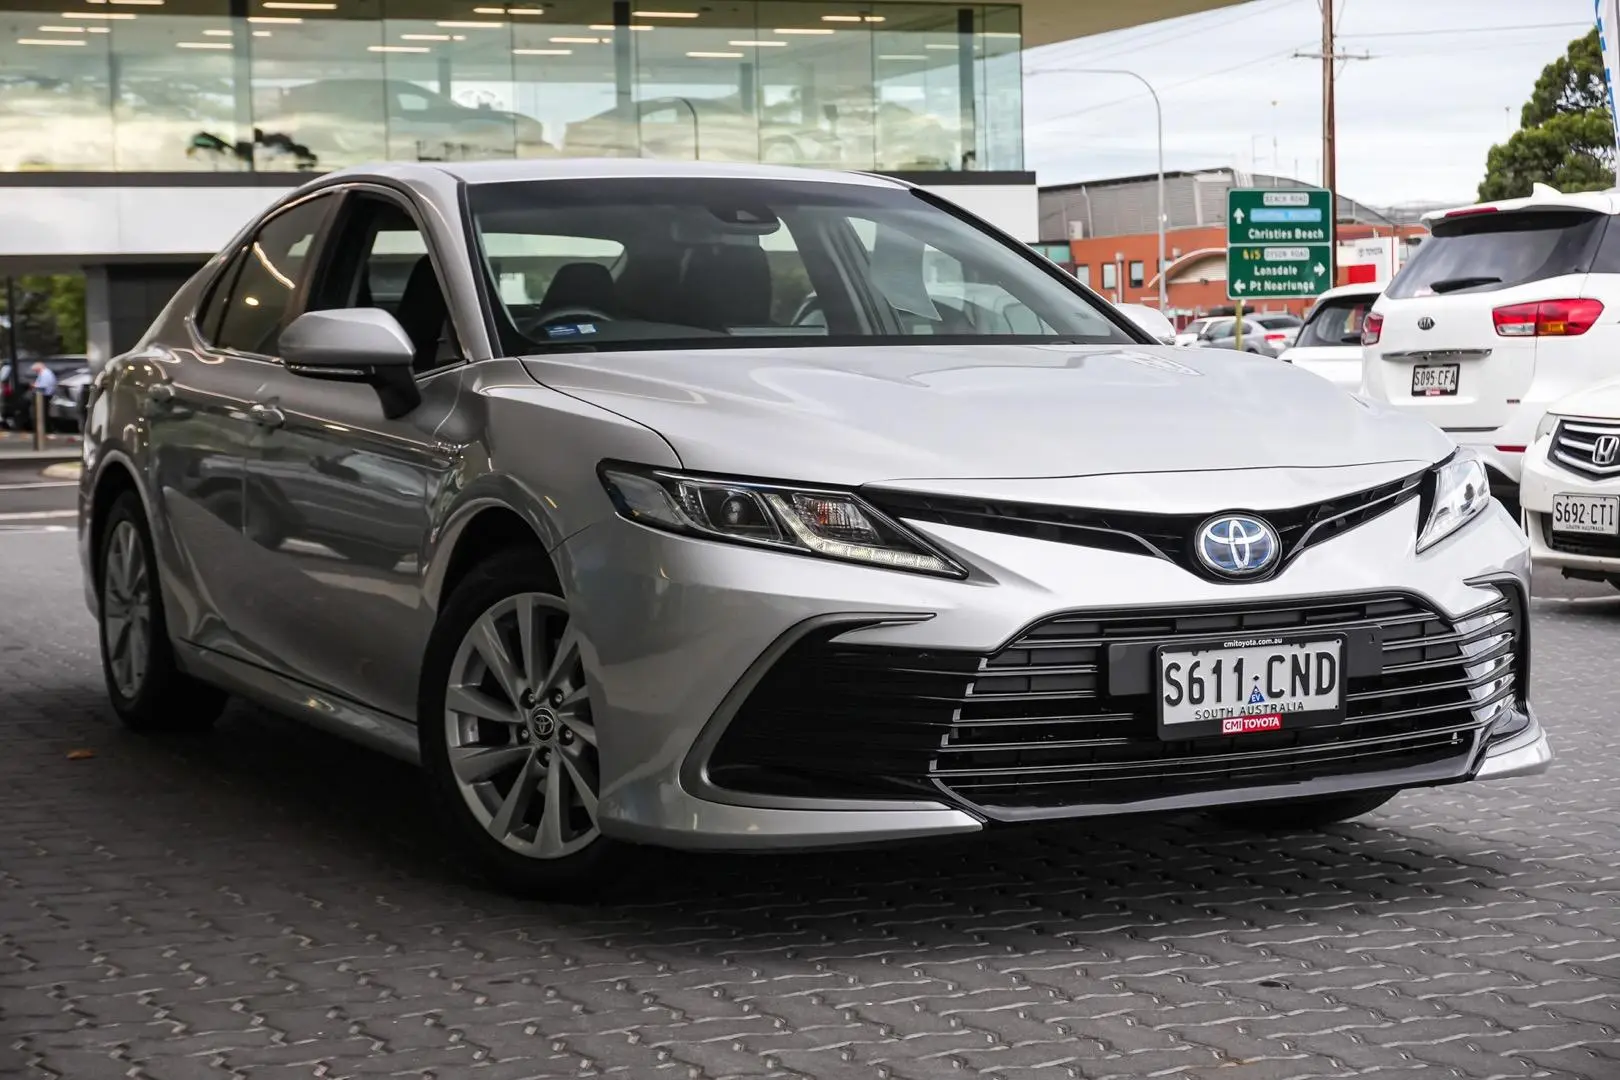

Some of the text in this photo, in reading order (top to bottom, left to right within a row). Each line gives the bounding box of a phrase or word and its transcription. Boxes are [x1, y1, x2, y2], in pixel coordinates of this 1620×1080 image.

[1248, 228, 1324, 240] Christies Beach
[1254, 265, 1298, 276] Lonsdale
[1249, 280, 1315, 294] Pt Noarlunga
[1223, 638, 1283, 648] cmitoyota.com.au
[1251, 693, 1262, 703] EV
[1194, 701, 1305, 720] SOUTH AUSTRALIA
[1223, 716, 1280, 732] CMI TOYOTA
